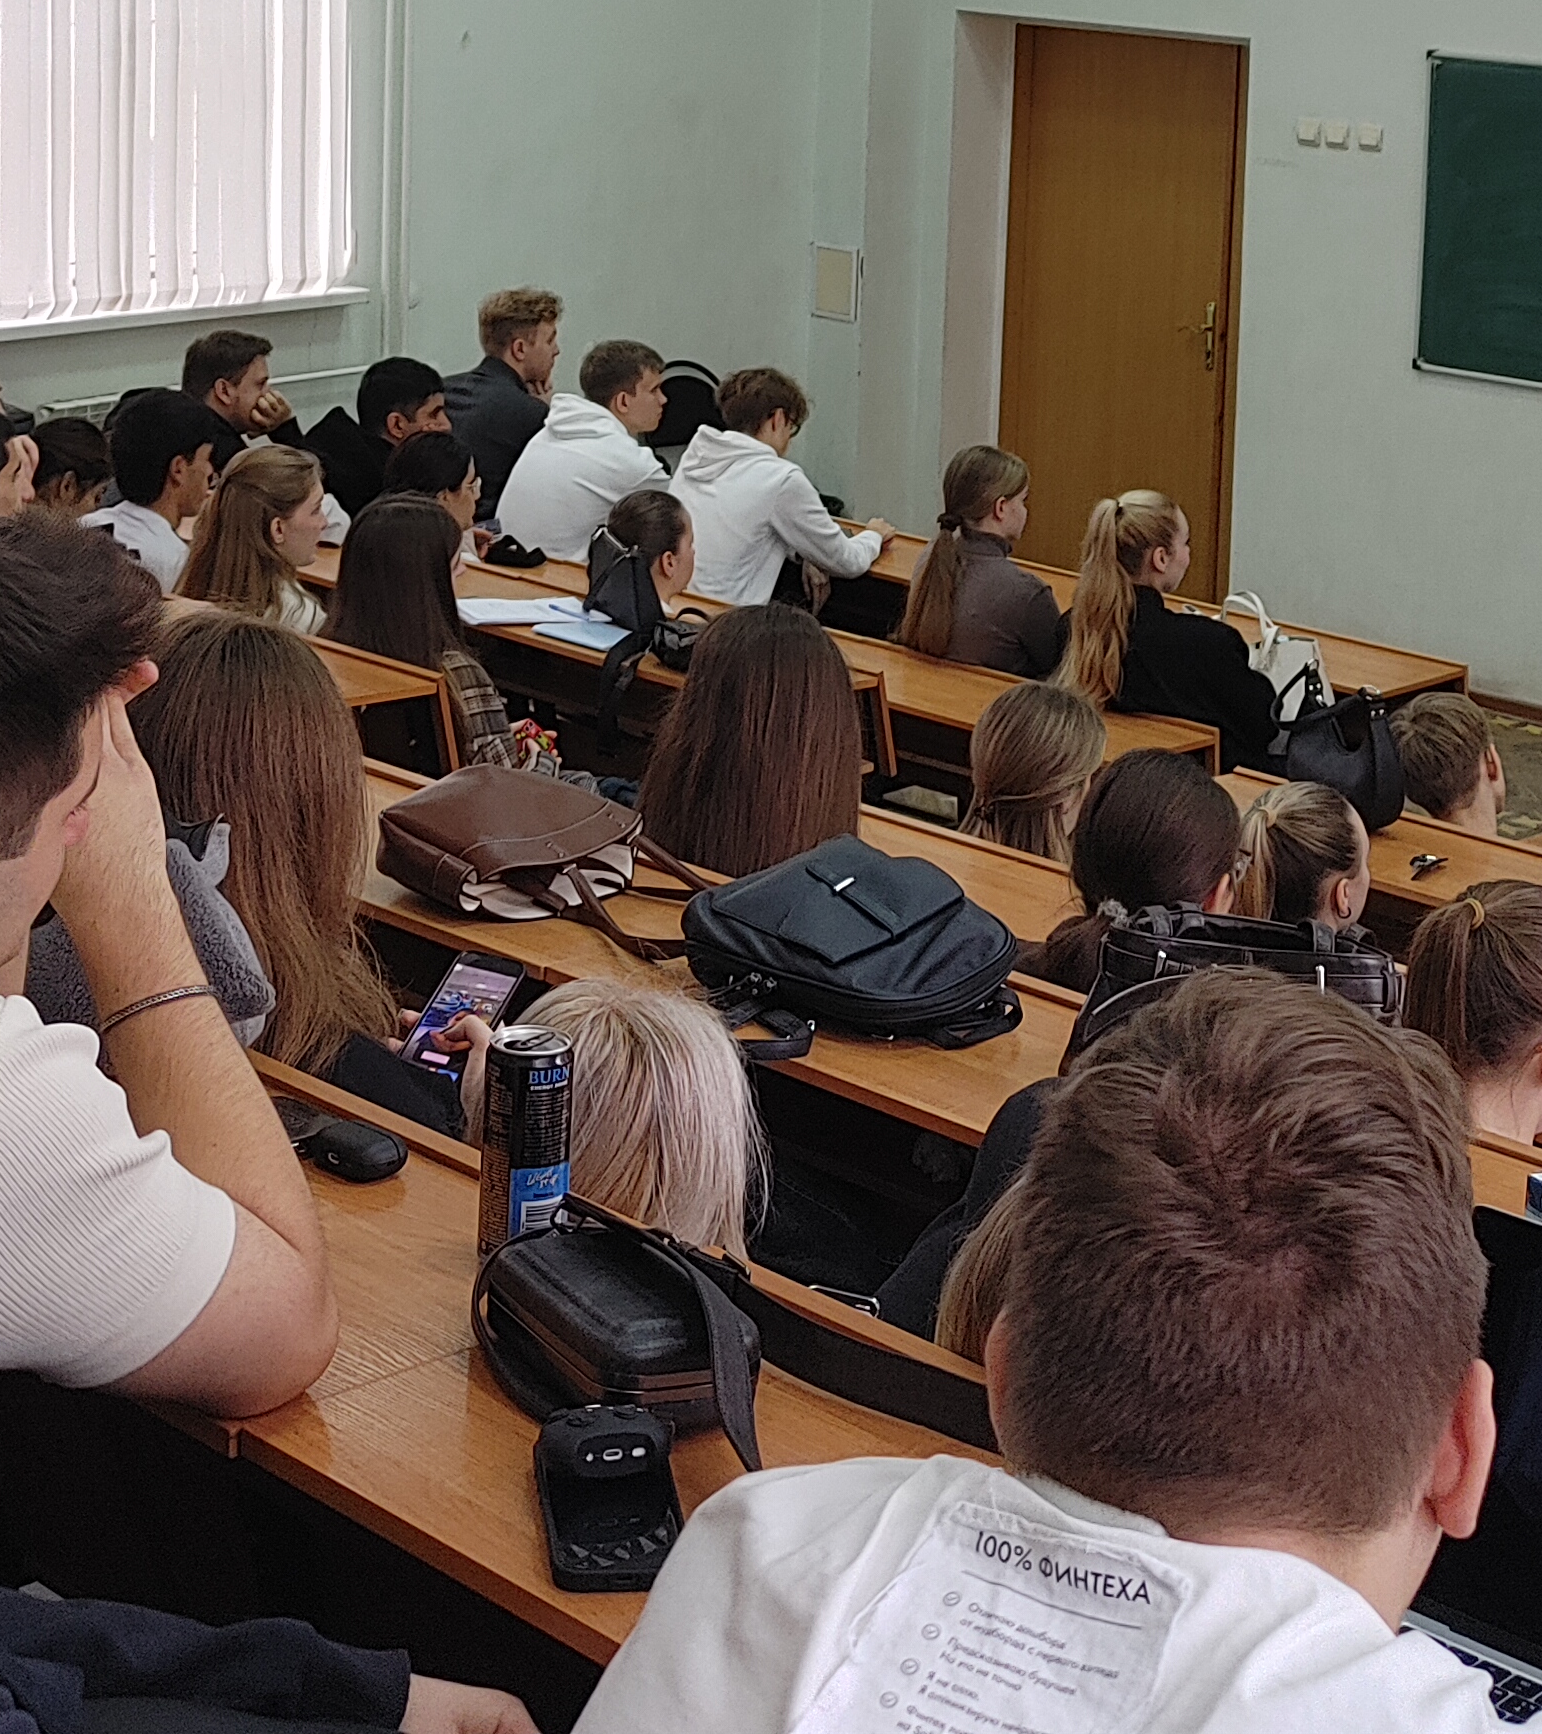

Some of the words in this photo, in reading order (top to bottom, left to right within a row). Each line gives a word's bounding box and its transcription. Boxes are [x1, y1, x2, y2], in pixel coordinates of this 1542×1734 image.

[528, 1064, 570, 1085] BURN
[975, 1530, 1033, 1572] 100%
[1038, 1556, 1151, 1605] ФИНТЕХА
[947, 1636, 1026, 1677] Предсказываю
[960, 1618, 974, 1628] от
[1027, 1646, 1035, 1655] с
[1035, 1650, 1078, 1669] первого
[940, 1650, 956, 1664] Но
[975, 1668, 989, 1678] не
[918, 1684, 928, 1695] Я
[926, 1671, 936, 1681] Я
[935, 1679, 950, 1688] не
